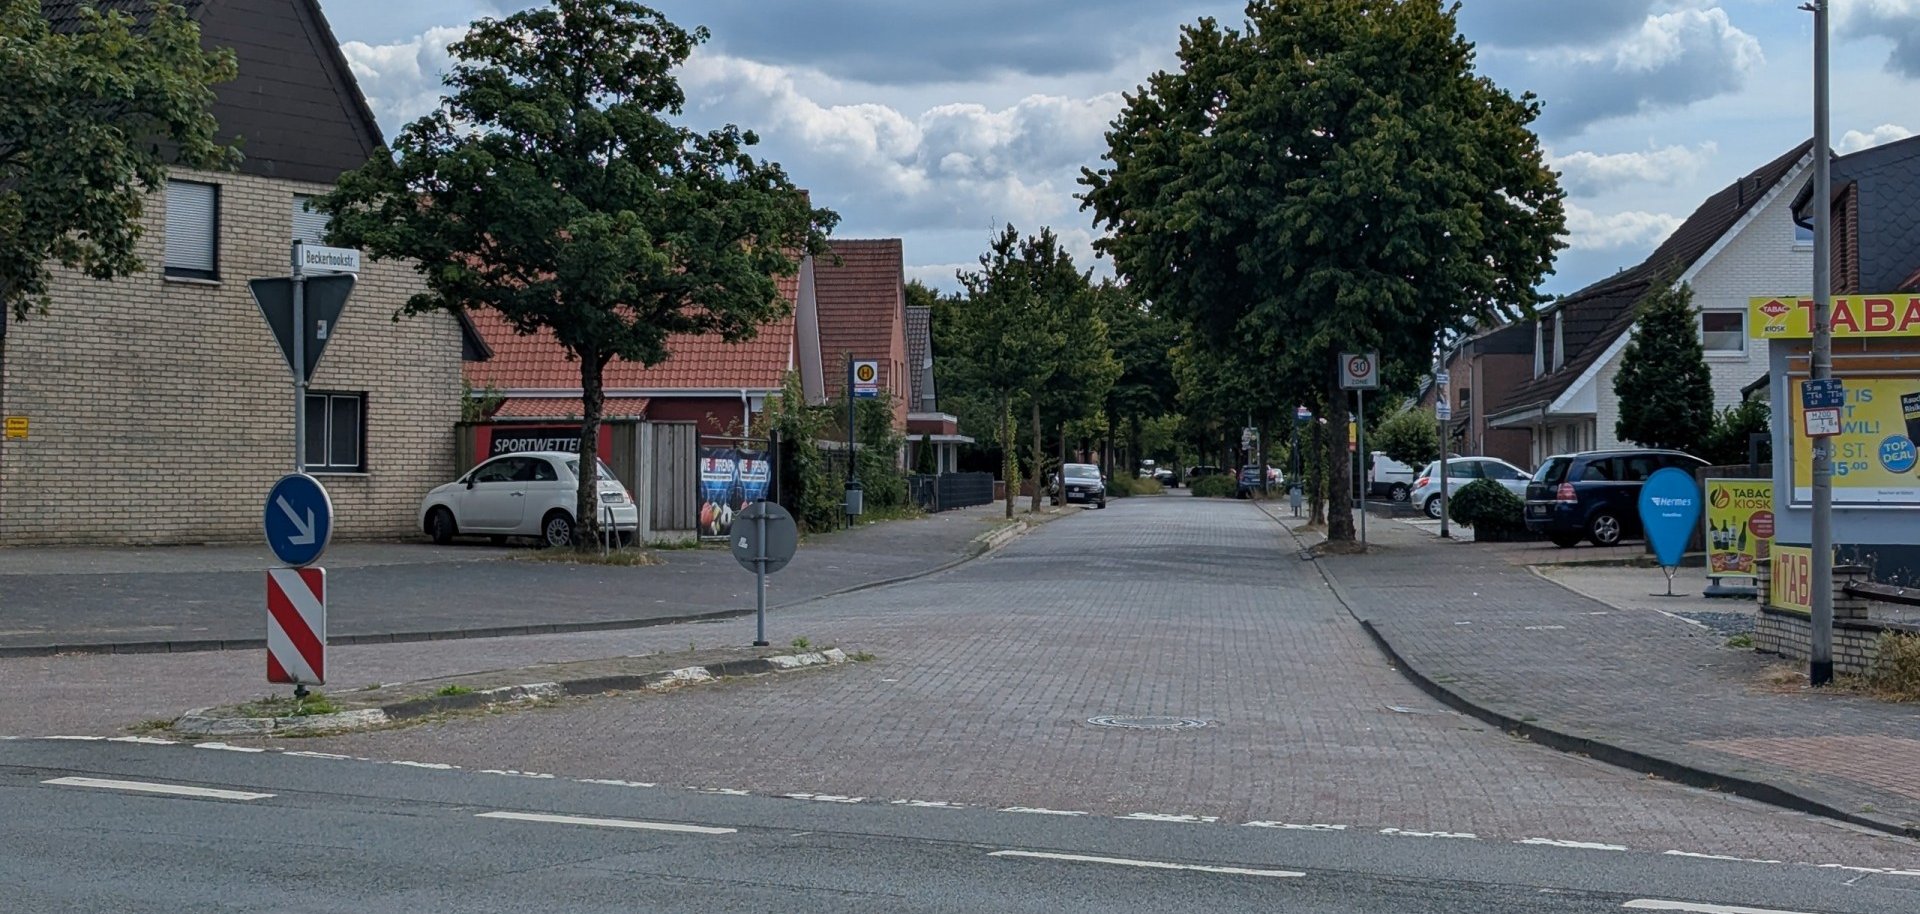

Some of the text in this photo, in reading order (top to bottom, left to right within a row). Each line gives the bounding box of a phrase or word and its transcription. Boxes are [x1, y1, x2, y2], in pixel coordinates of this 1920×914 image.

[1353, 362, 1366, 372] 30
[1856, 389, 1873, 402] IS
[1883, 441, 1907, 452] TOP
[1883, 451, 1914, 463] DEAL
[1733, 489, 1771, 498] TABAC
[1661, 498, 1691, 506] Hermes
[1734, 499, 1771, 510] KIOSK
